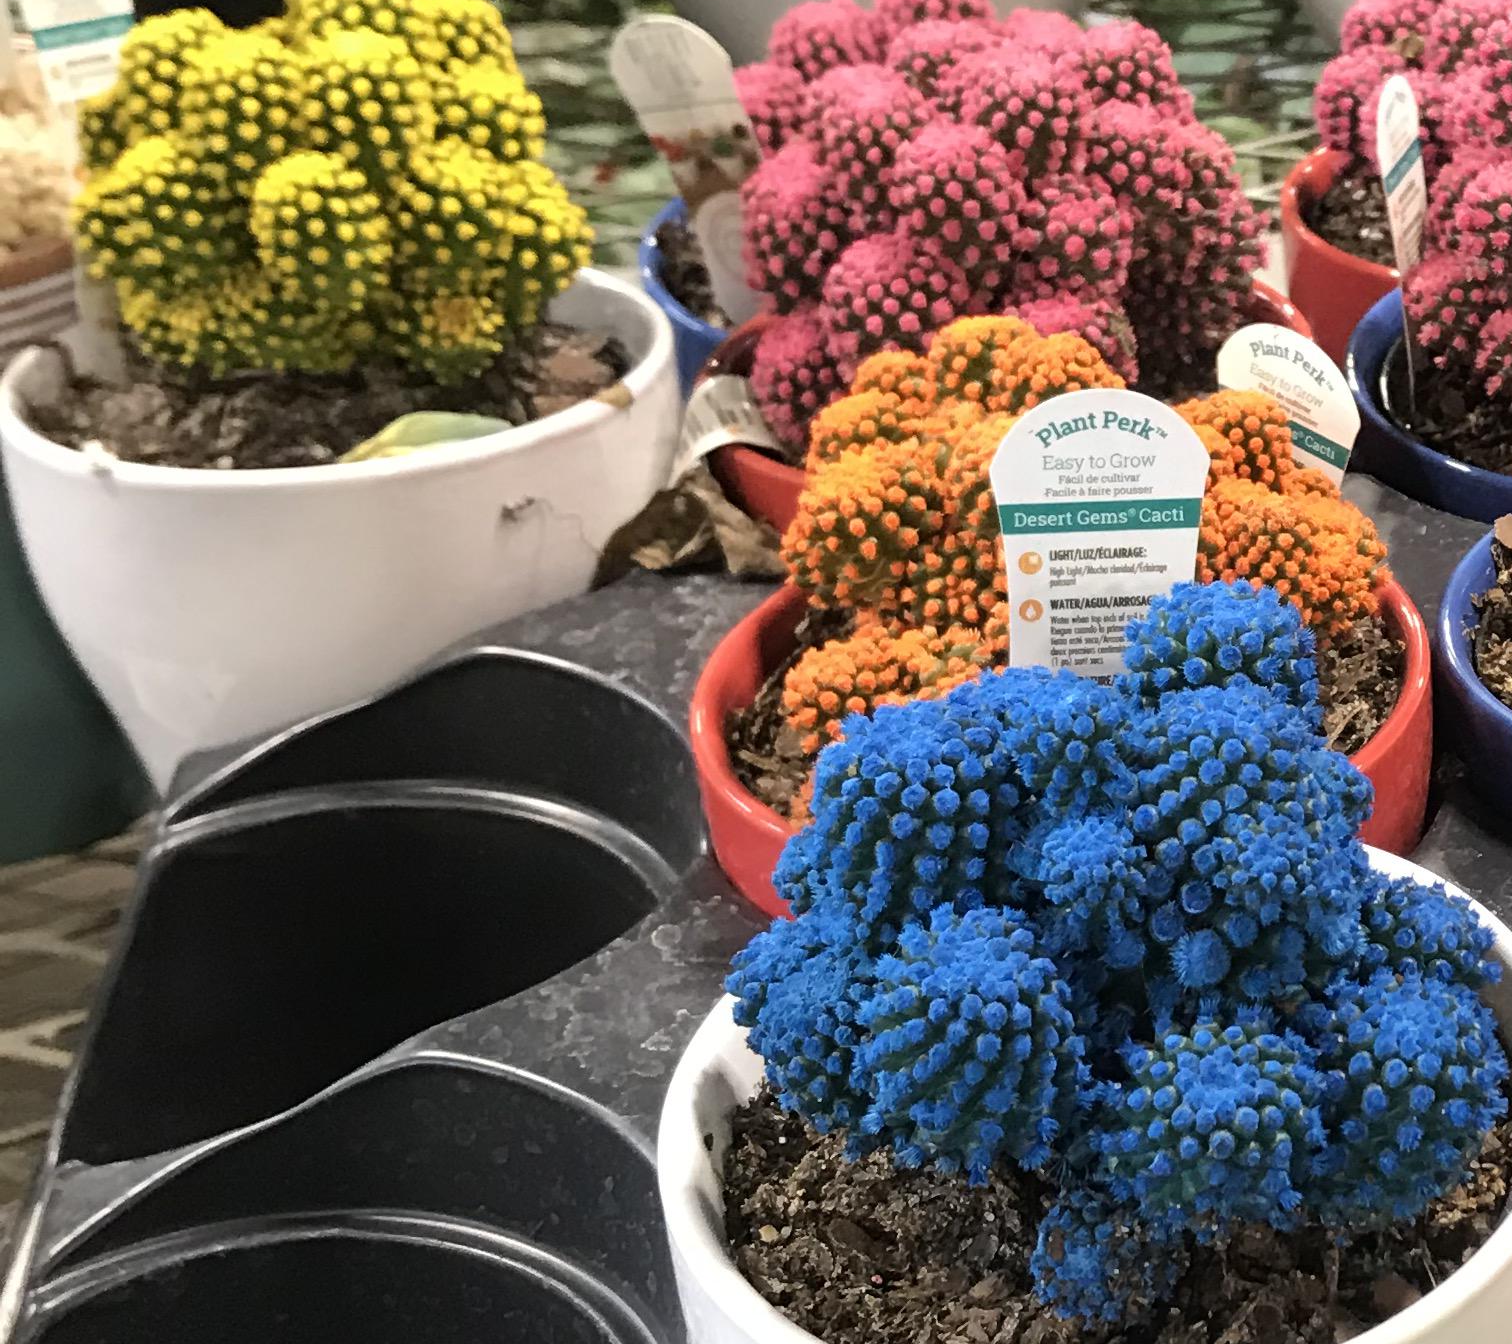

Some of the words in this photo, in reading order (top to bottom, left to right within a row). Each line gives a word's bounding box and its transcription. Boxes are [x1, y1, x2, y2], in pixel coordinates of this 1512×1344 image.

[1249, 340, 1290, 360] Plant
[1249, 362, 1278, 386] Easy
[1279, 378, 1292, 393] to
[1293, 384, 1325, 408] Grow
[1035, 412, 1098, 448] Plant
[1304, 435, 1336, 460] Cacti
[1042, 455, 1085, 473] Easy
[1089, 456, 1106, 469] to
[1110, 453, 1156, 469] Grow
[1058, 474, 1084, 485] Fácil
[1086, 474, 1099, 484] de
[1101, 473, 1141, 483] cultivar
[1044, 487, 1077, 498] Facile
[1078, 487, 1086, 497] à
[1087, 486, 1112, 497] faire
[1113, 486, 1154, 498] pousser
[1014, 511, 1073, 528] Desert
[1139, 506, 1185, 523] Cacti
